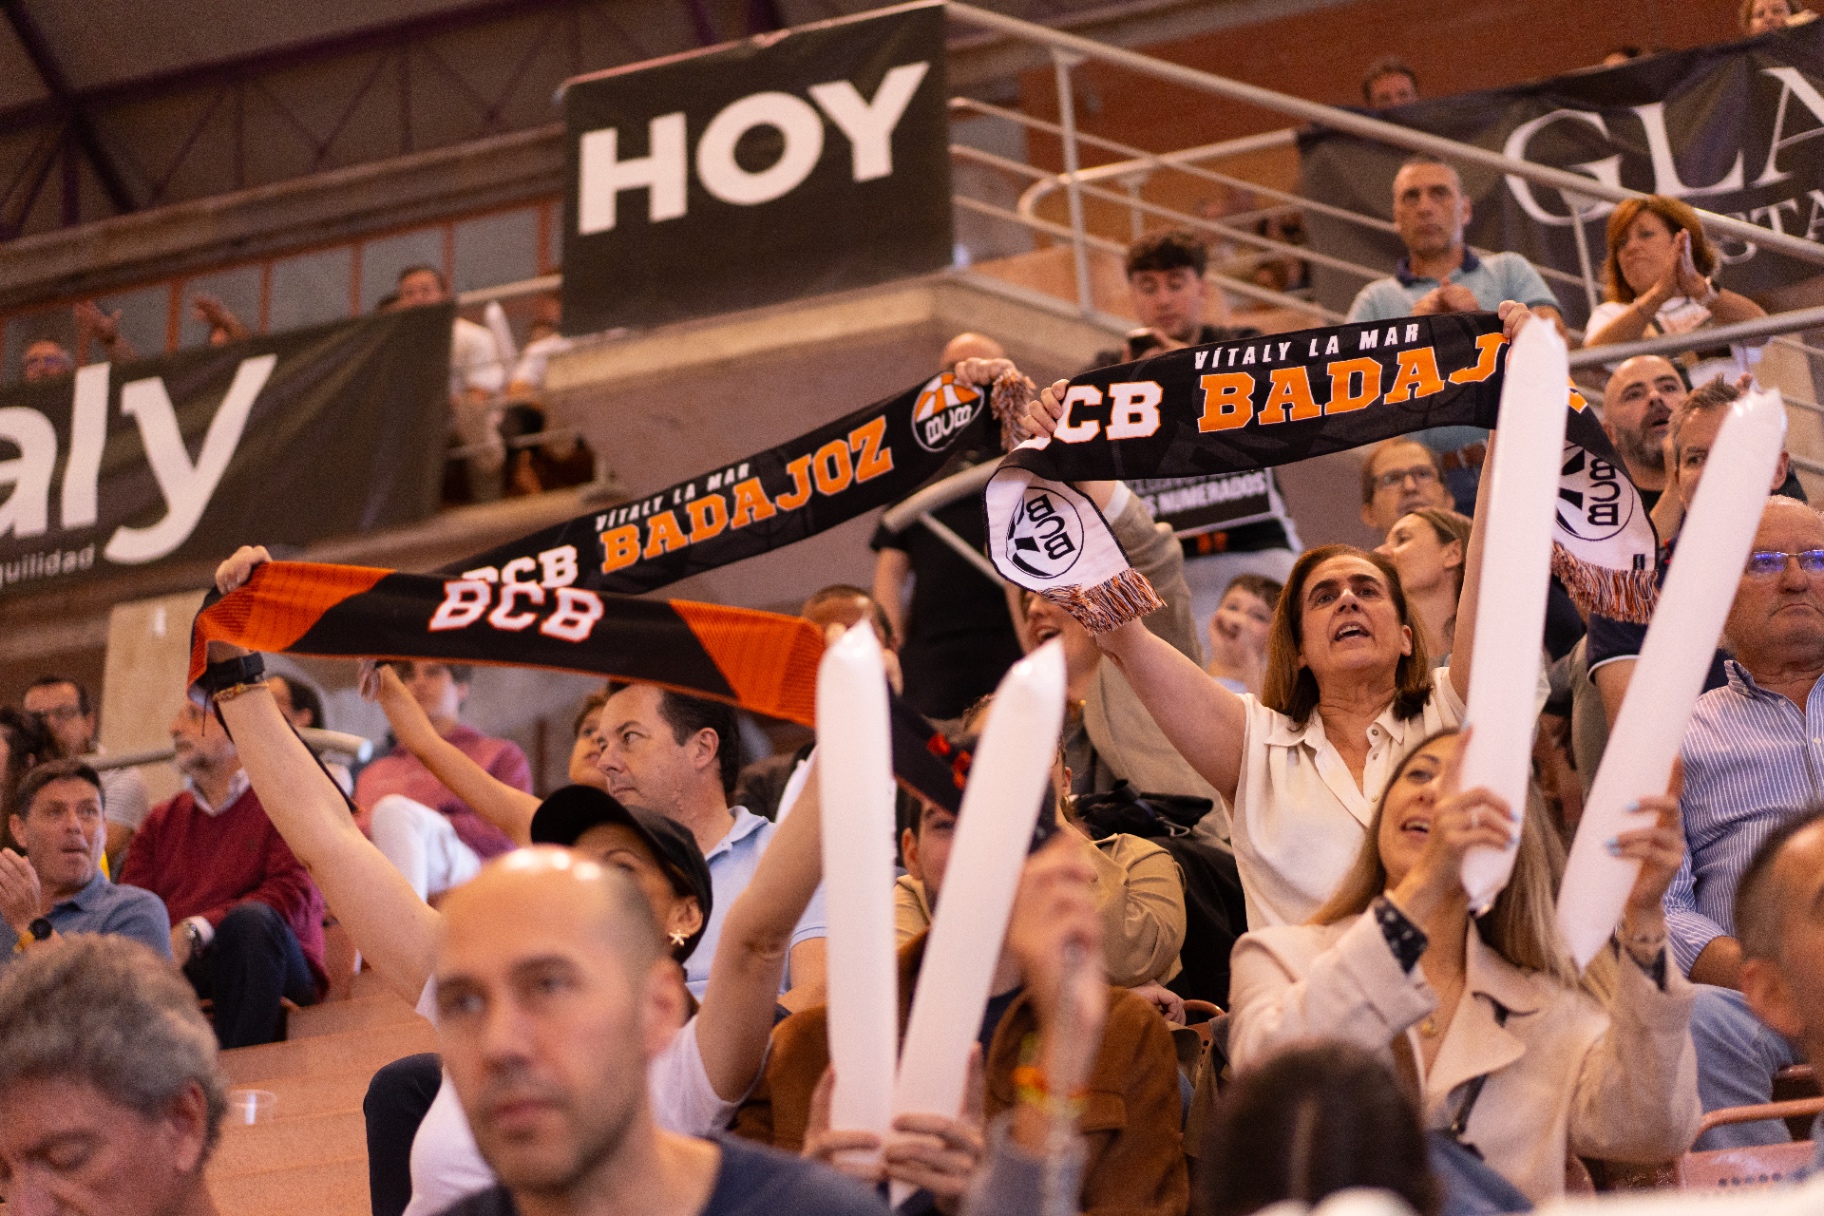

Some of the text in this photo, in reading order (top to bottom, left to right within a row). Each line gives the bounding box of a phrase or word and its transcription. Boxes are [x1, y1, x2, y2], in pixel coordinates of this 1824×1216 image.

[579, 61, 930, 235] HOY
[1309, 335, 1340, 358] LA
[1359, 323, 1420, 350] MAR
[1012, 380, 1164, 450] CB
[1197, 332, 1588, 433] BADAJ
[600, 415, 894, 574] BADAJOZ
[673, 483, 696, 505] LA
[707, 462, 749, 491] MAR
[0, 542, 96, 590] uilidad
[427, 580, 605, 644] BCB
